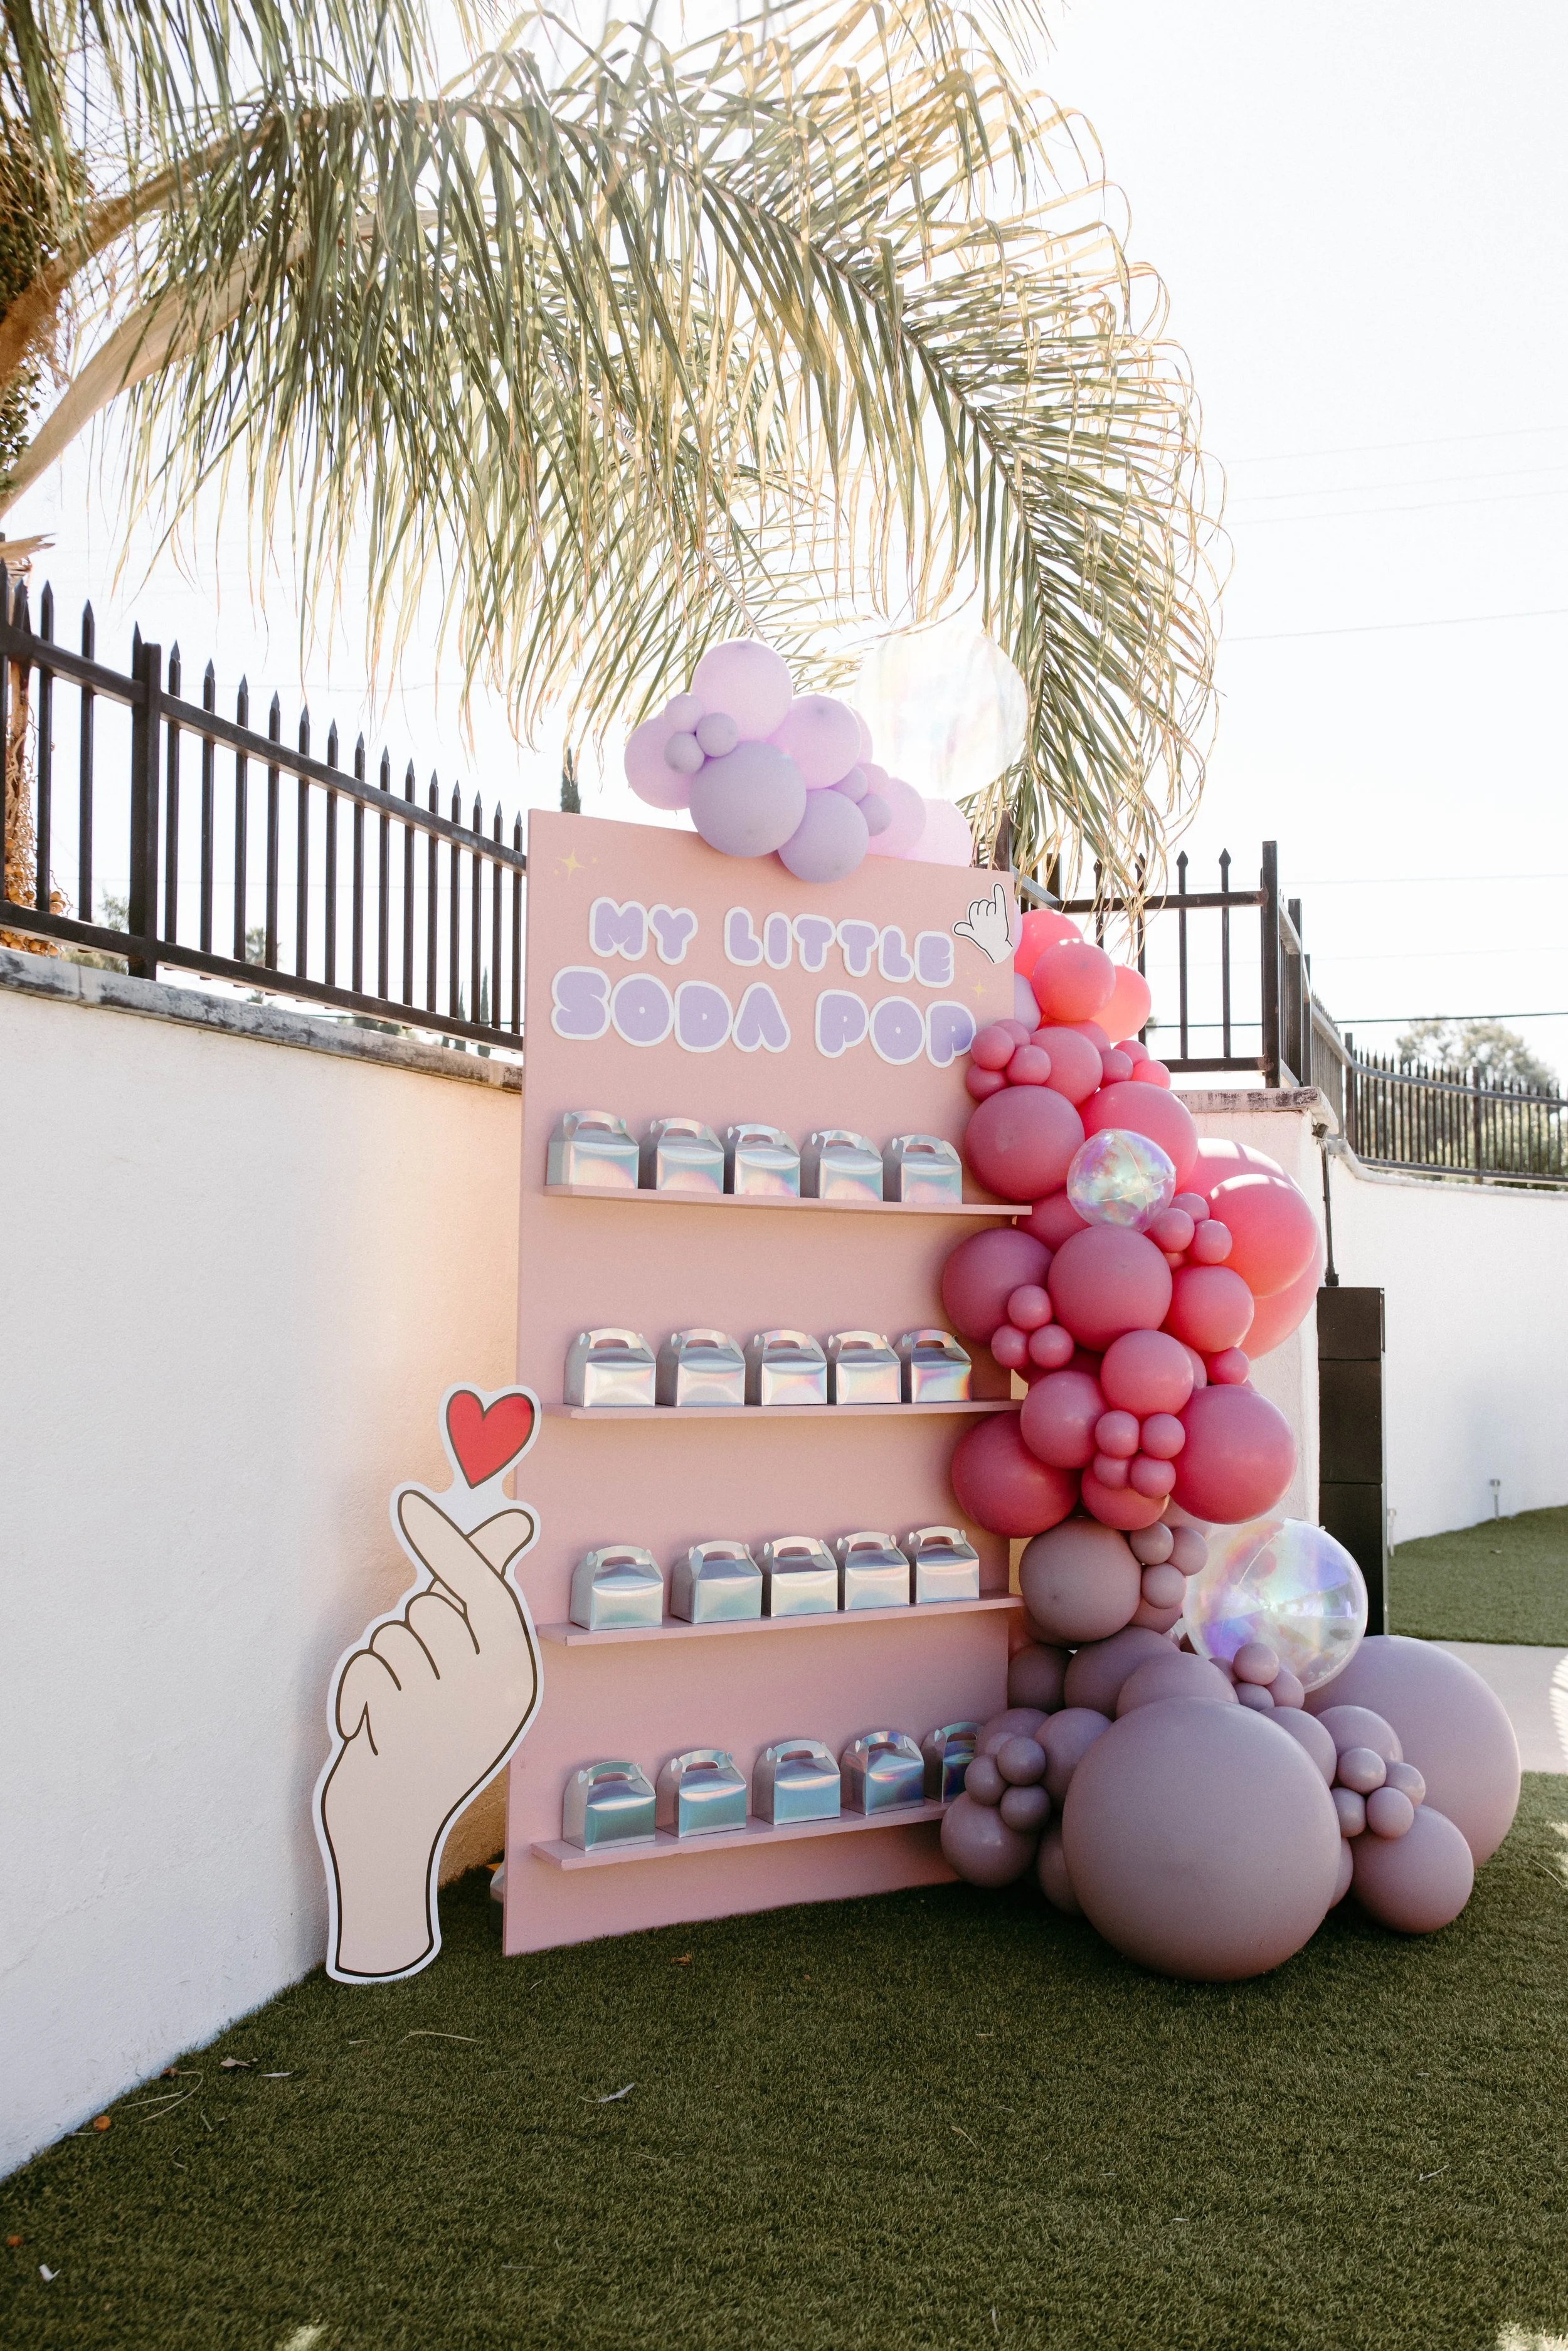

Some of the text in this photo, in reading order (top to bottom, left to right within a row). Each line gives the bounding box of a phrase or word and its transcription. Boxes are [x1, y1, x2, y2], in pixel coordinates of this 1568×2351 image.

[589, 896, 955, 988] MY LITTLE
[551, 966, 977, 1068] SODA POP
